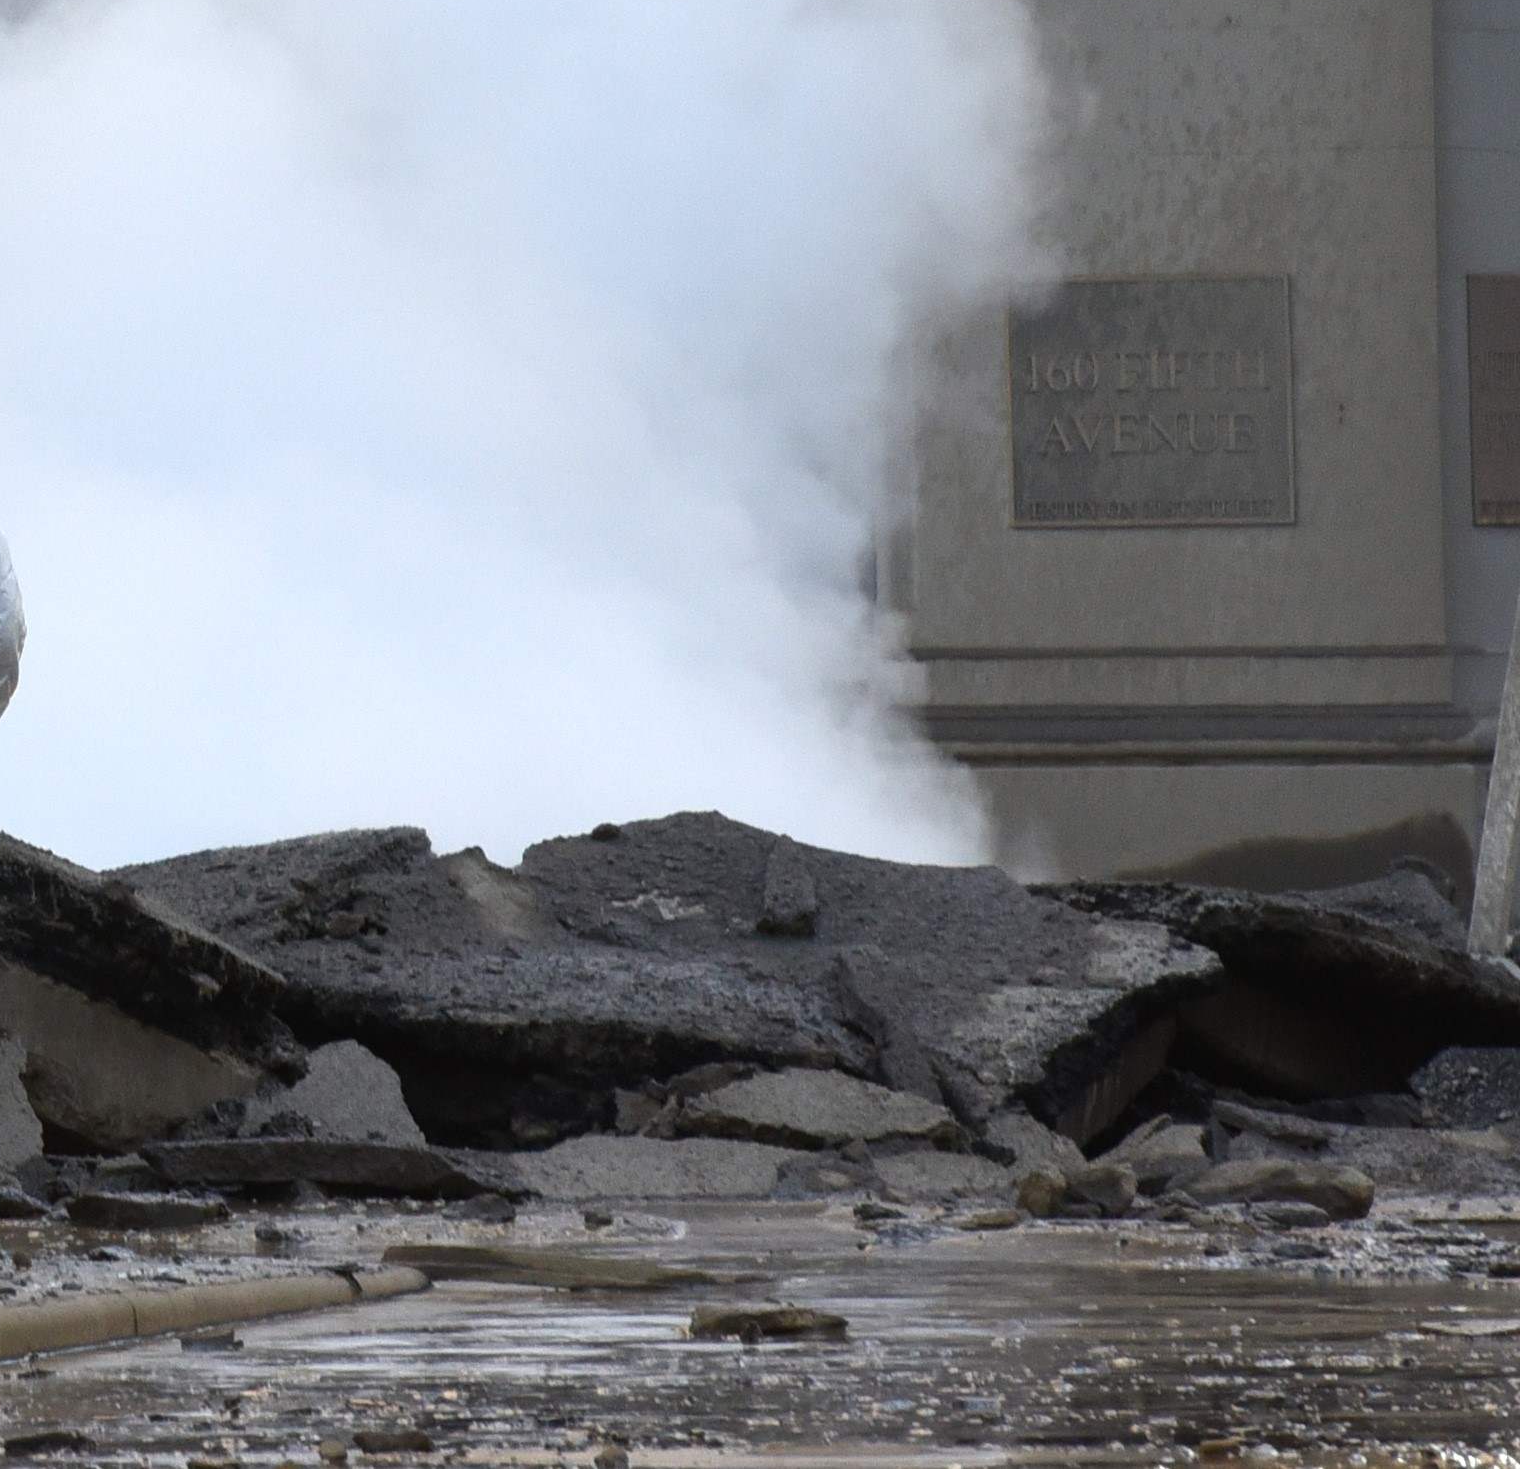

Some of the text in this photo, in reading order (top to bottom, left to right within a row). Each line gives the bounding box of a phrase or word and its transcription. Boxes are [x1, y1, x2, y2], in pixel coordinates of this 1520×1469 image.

[1025, 351, 1271, 394] 160 FIFTH
[1037, 413, 1259, 458] AVENUE
